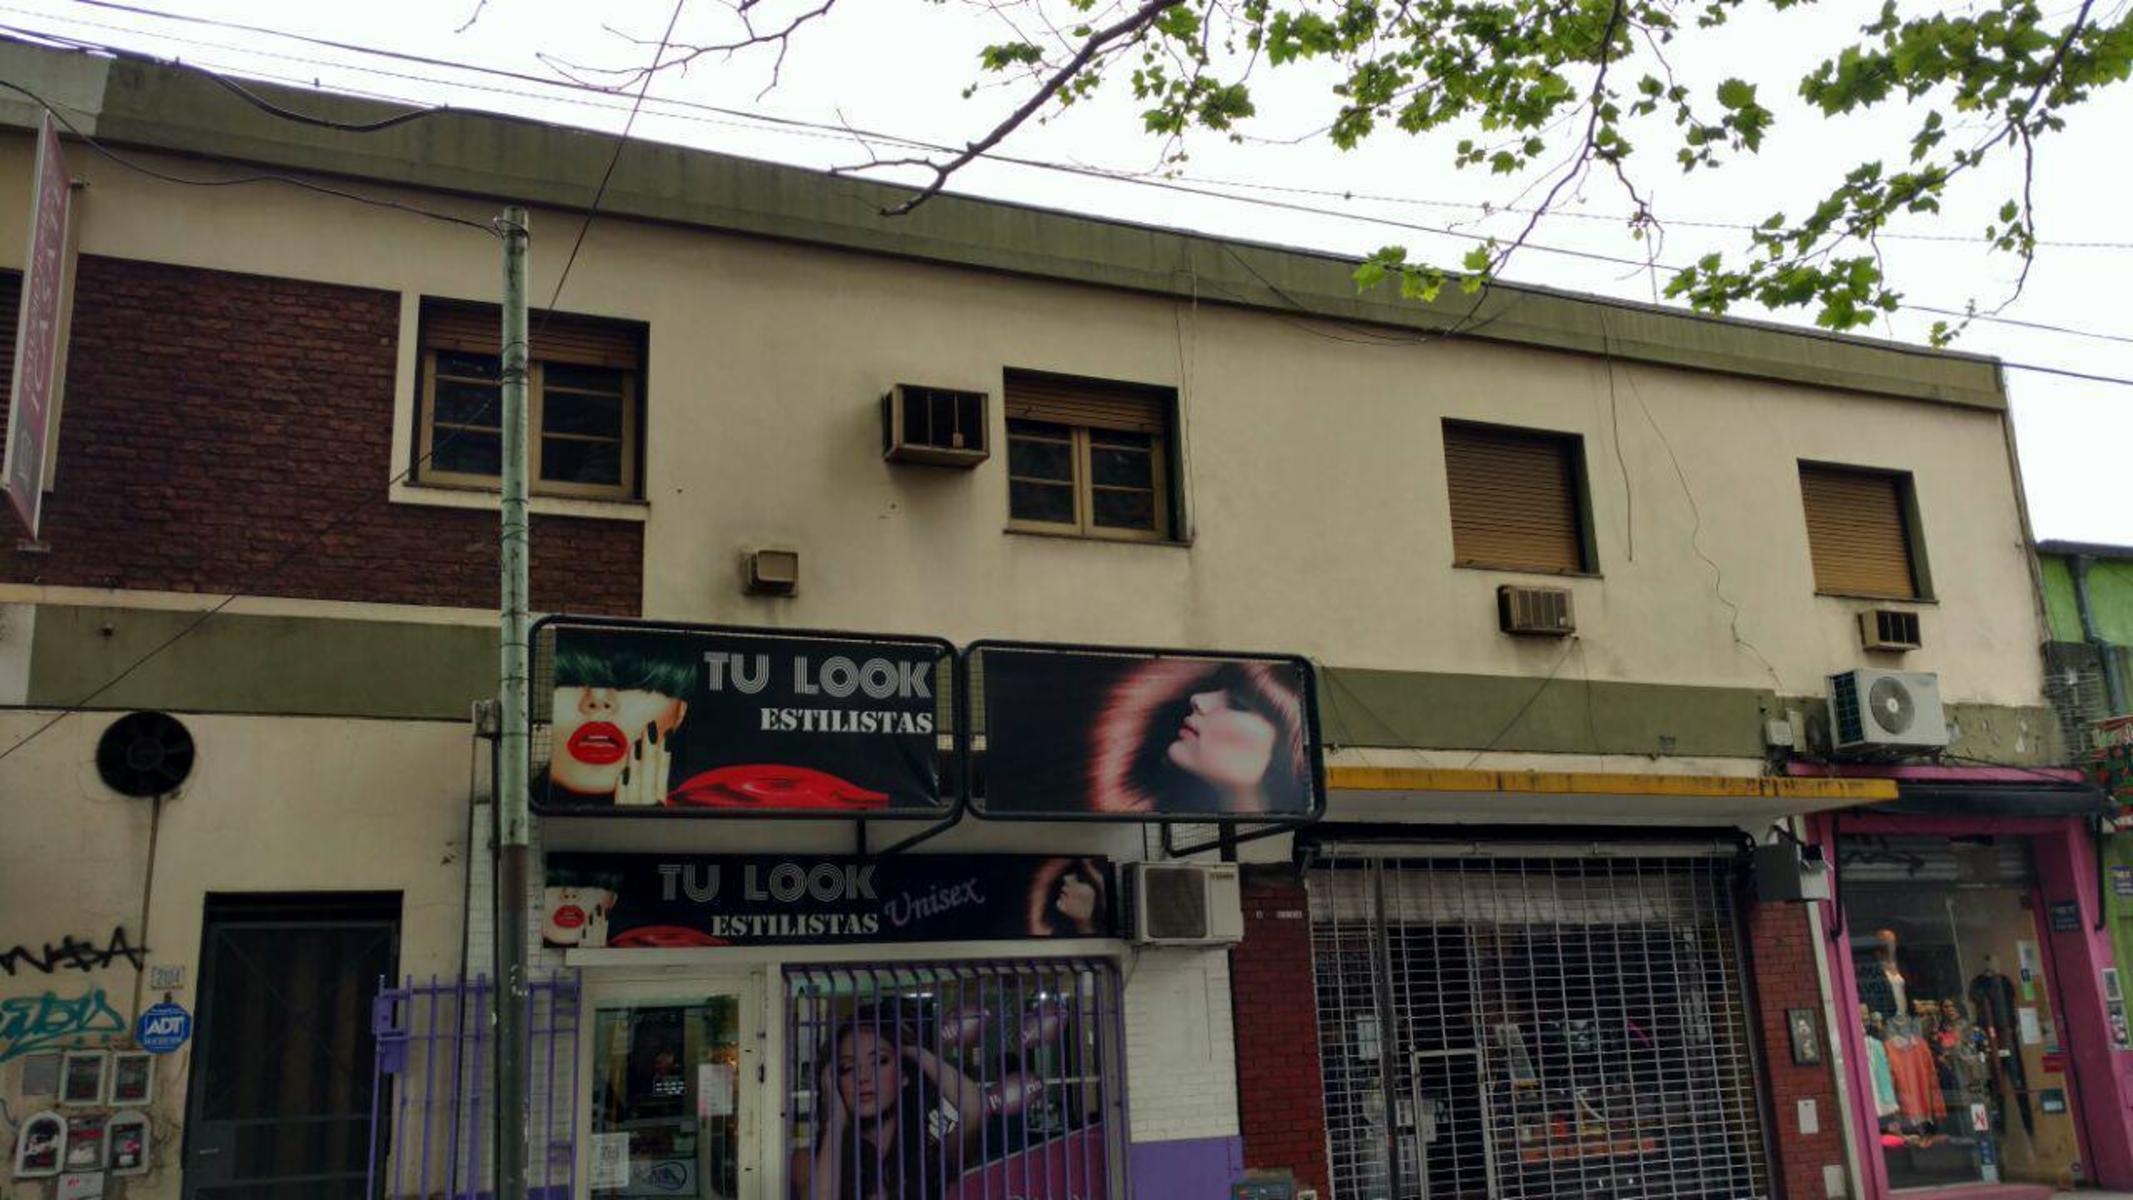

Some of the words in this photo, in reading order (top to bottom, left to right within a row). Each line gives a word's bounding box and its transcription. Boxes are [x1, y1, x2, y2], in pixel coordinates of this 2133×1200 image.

[704, 652, 770, 695] TU
[794, 655, 932, 699] LOOK
[759, 707, 934, 735] ESTILISTAS
[658, 863, 721, 903] TU
[743, 862, 879, 903] LOOK
[883, 877, 986, 928] Unisex
[711, 913, 880, 938] ESTILISTAS
[146, 1016, 185, 1035] ADT
